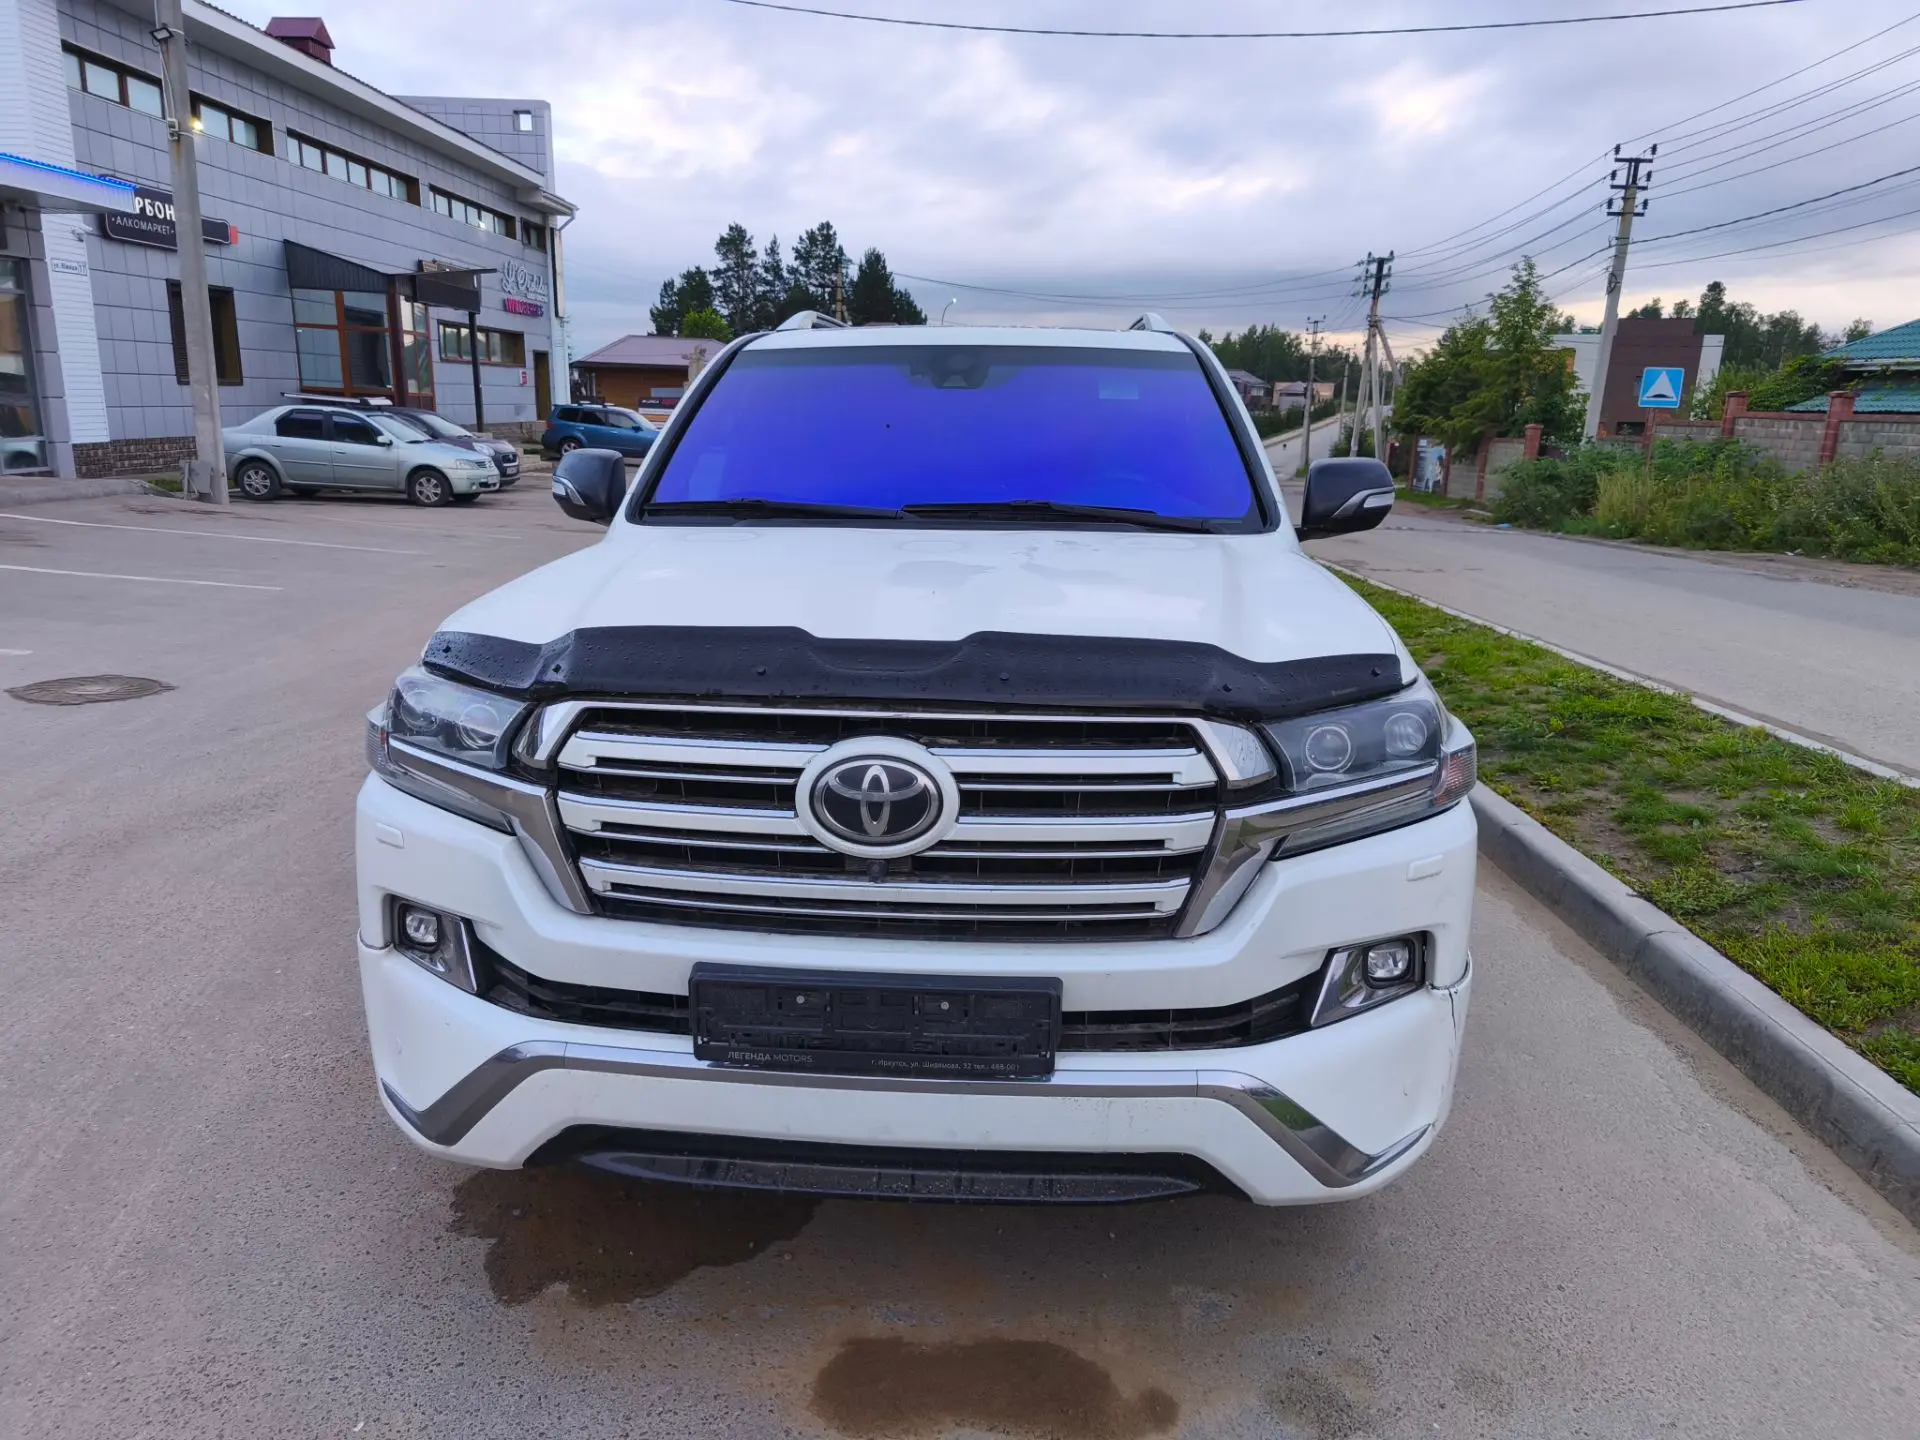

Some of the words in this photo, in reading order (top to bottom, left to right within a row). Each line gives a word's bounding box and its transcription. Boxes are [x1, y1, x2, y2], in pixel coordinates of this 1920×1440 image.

[116, 215, 170, 235] АЛКОМАРКЕТ
[727, 1051, 772, 1061] ЛЕГЕНДА
[773, 1053, 814, 1063] MOTORS
